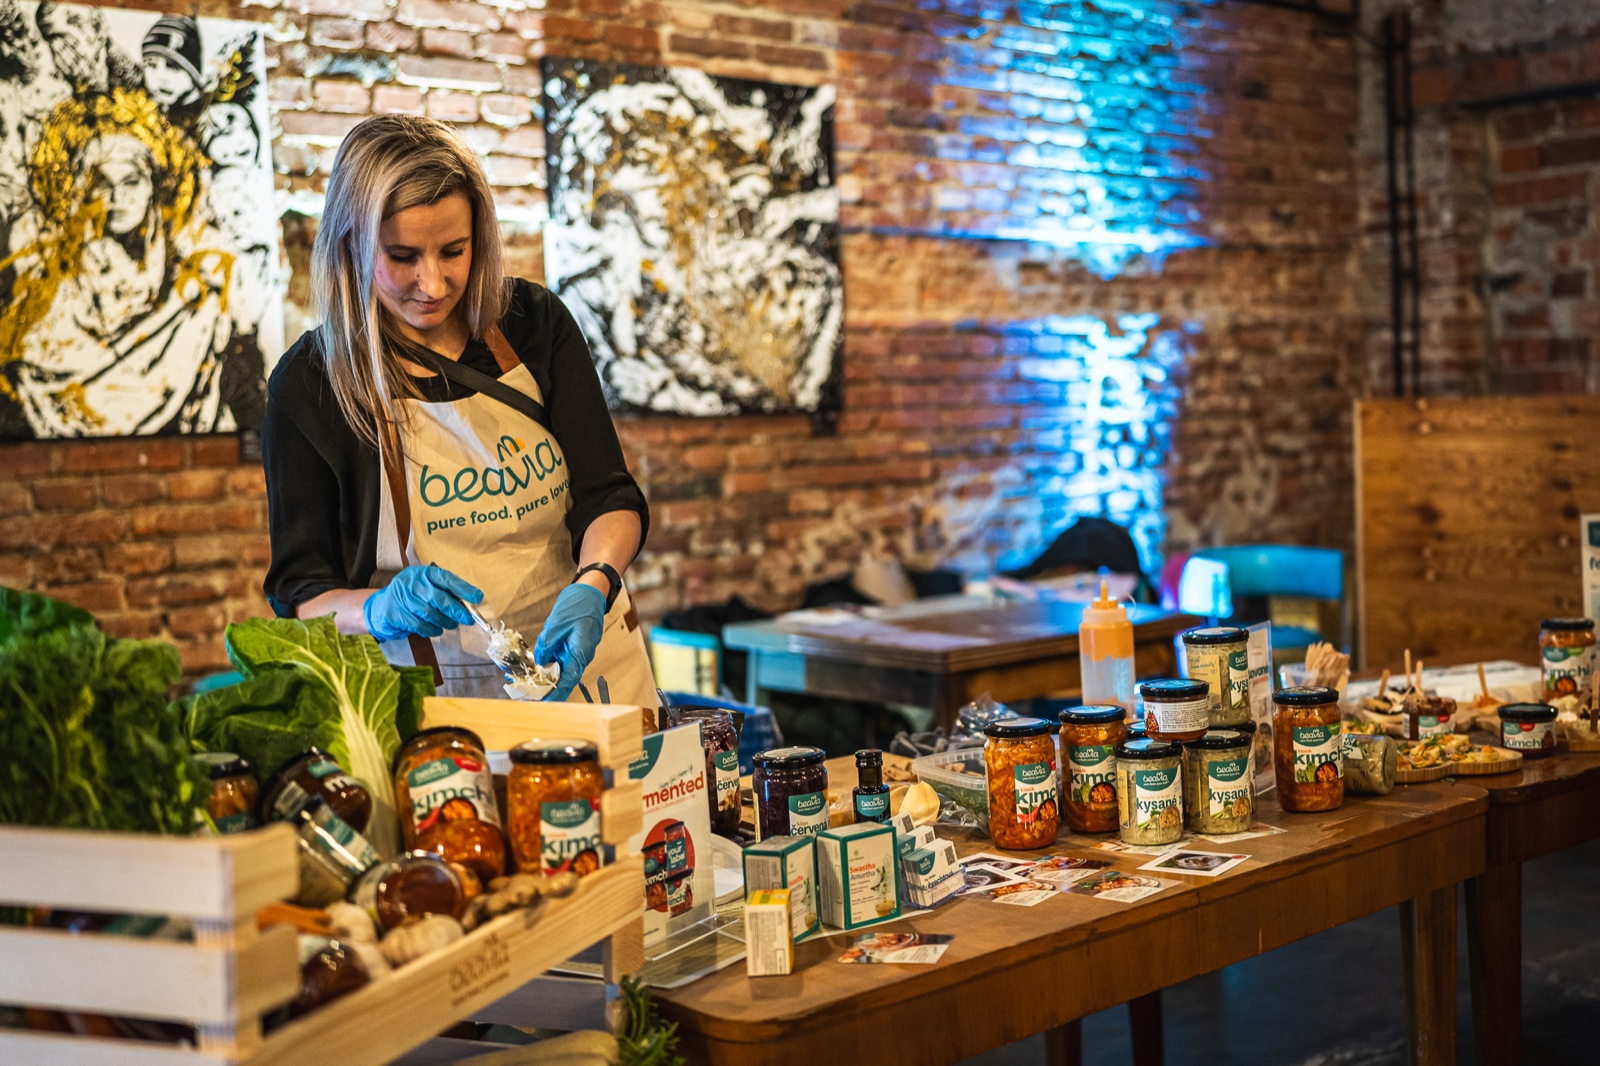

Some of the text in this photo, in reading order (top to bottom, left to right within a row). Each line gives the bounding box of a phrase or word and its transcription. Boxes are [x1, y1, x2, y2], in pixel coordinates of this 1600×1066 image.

[419, 435, 563, 508] beavia
[426, 515, 467, 535] pure
[470, 505, 513, 525] food.
[516, 496, 549, 521] pure
[1299, 728, 1324, 739] beavia
[1022, 764, 1046, 777] beavia
[797, 795, 821, 808] beavia
